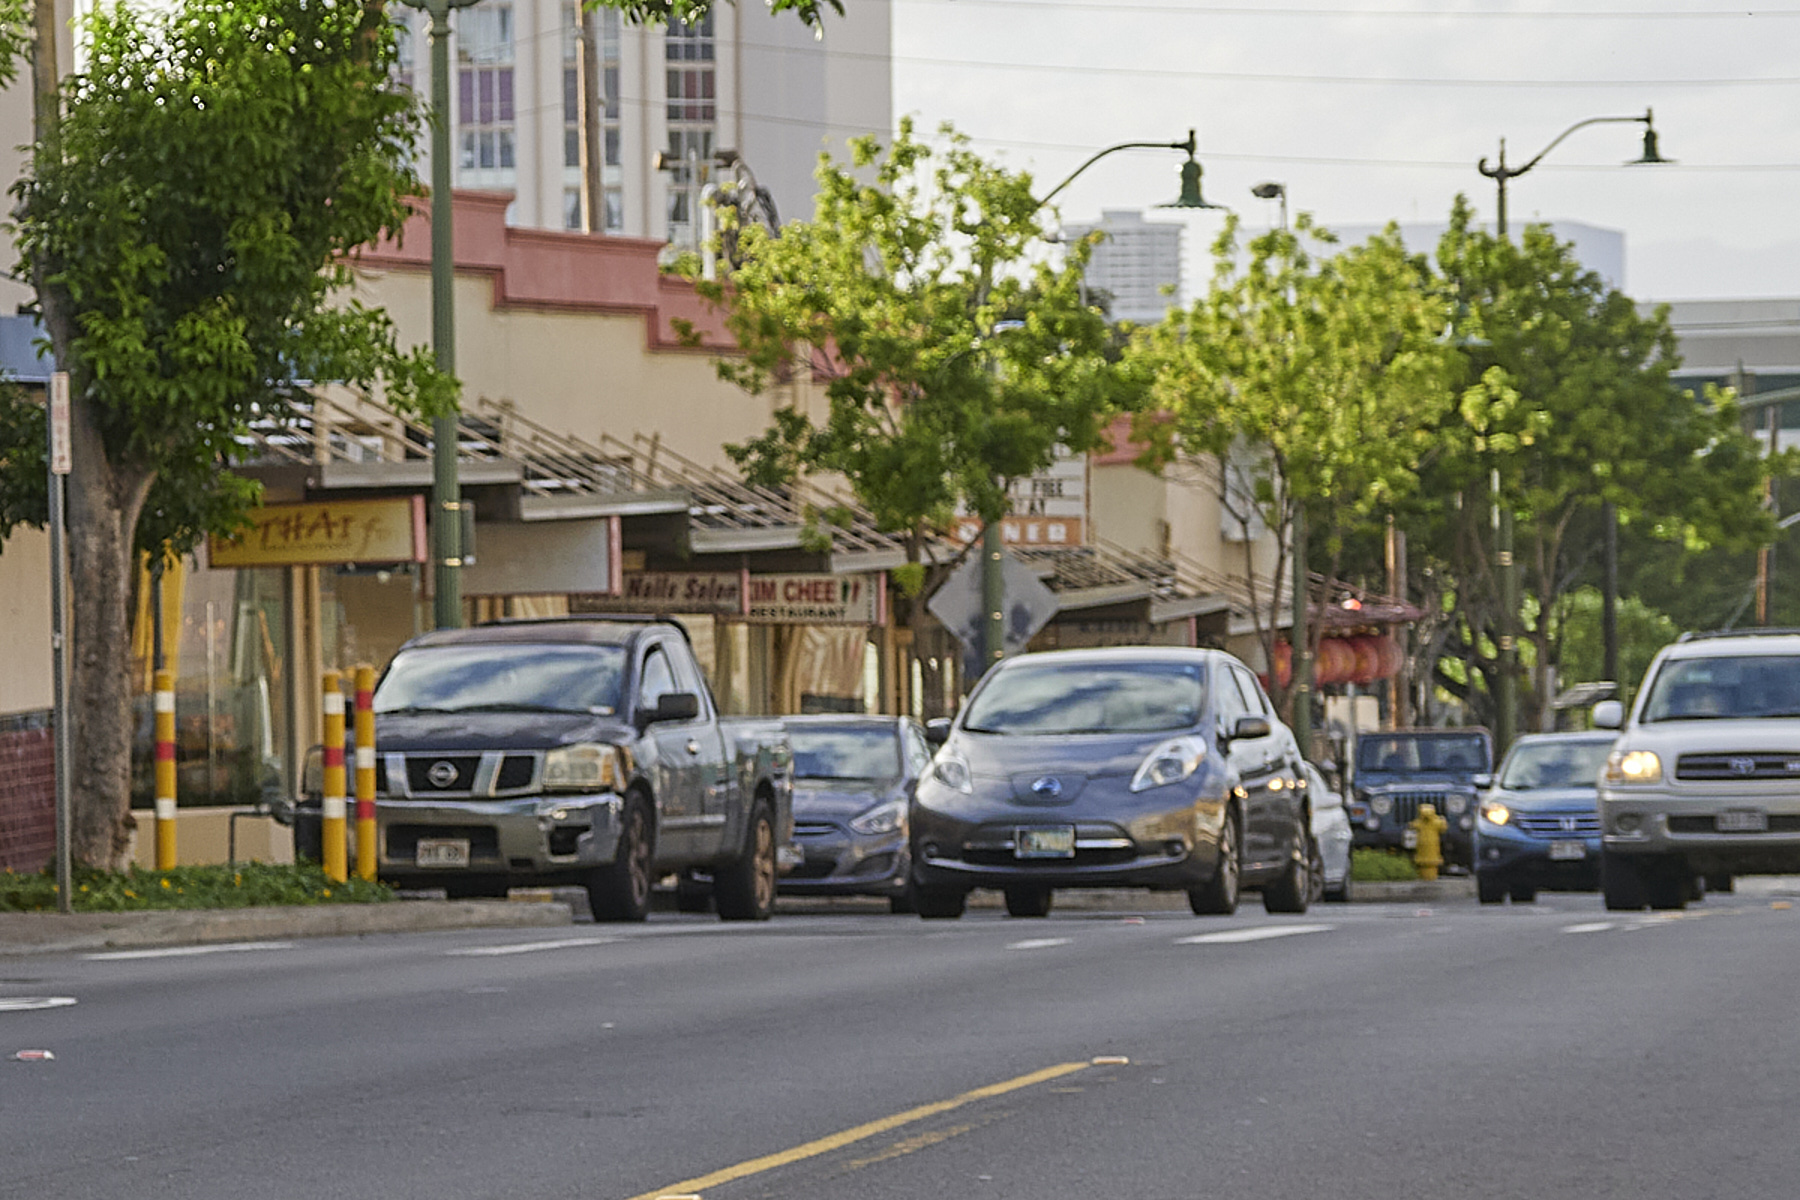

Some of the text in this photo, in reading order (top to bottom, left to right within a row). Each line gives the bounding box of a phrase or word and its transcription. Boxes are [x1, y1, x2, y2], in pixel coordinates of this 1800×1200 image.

[258, 508, 354, 546] THAI
[783, 578, 837, 603] CHEE
[749, 605, 846, 618] RESTAURANT
